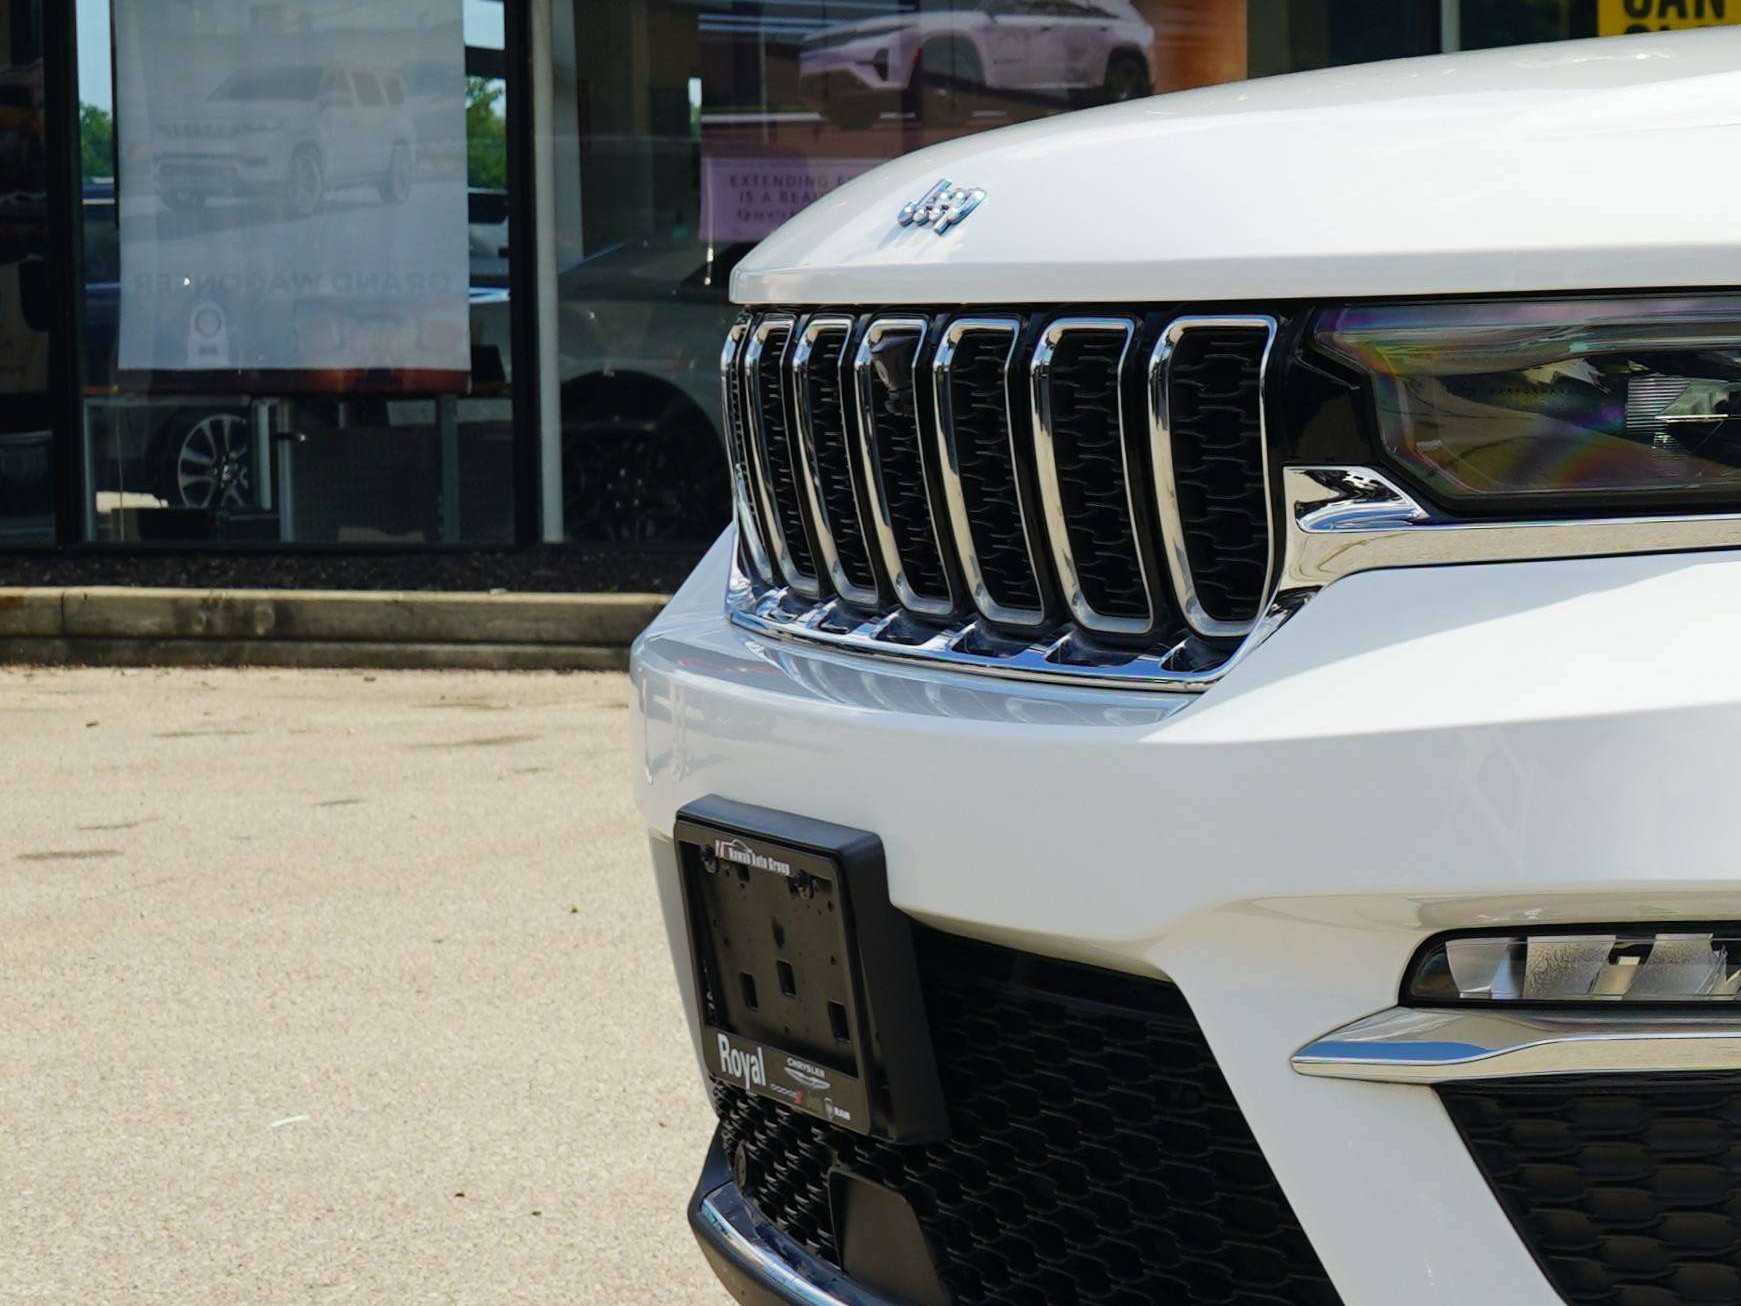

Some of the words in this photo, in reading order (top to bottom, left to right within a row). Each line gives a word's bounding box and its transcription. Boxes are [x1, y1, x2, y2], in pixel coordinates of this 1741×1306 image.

[897, 178, 987, 236] Jeep
[717, 1032, 767, 1091] Royal
[786, 1056, 826, 1079] CHRYSLER
